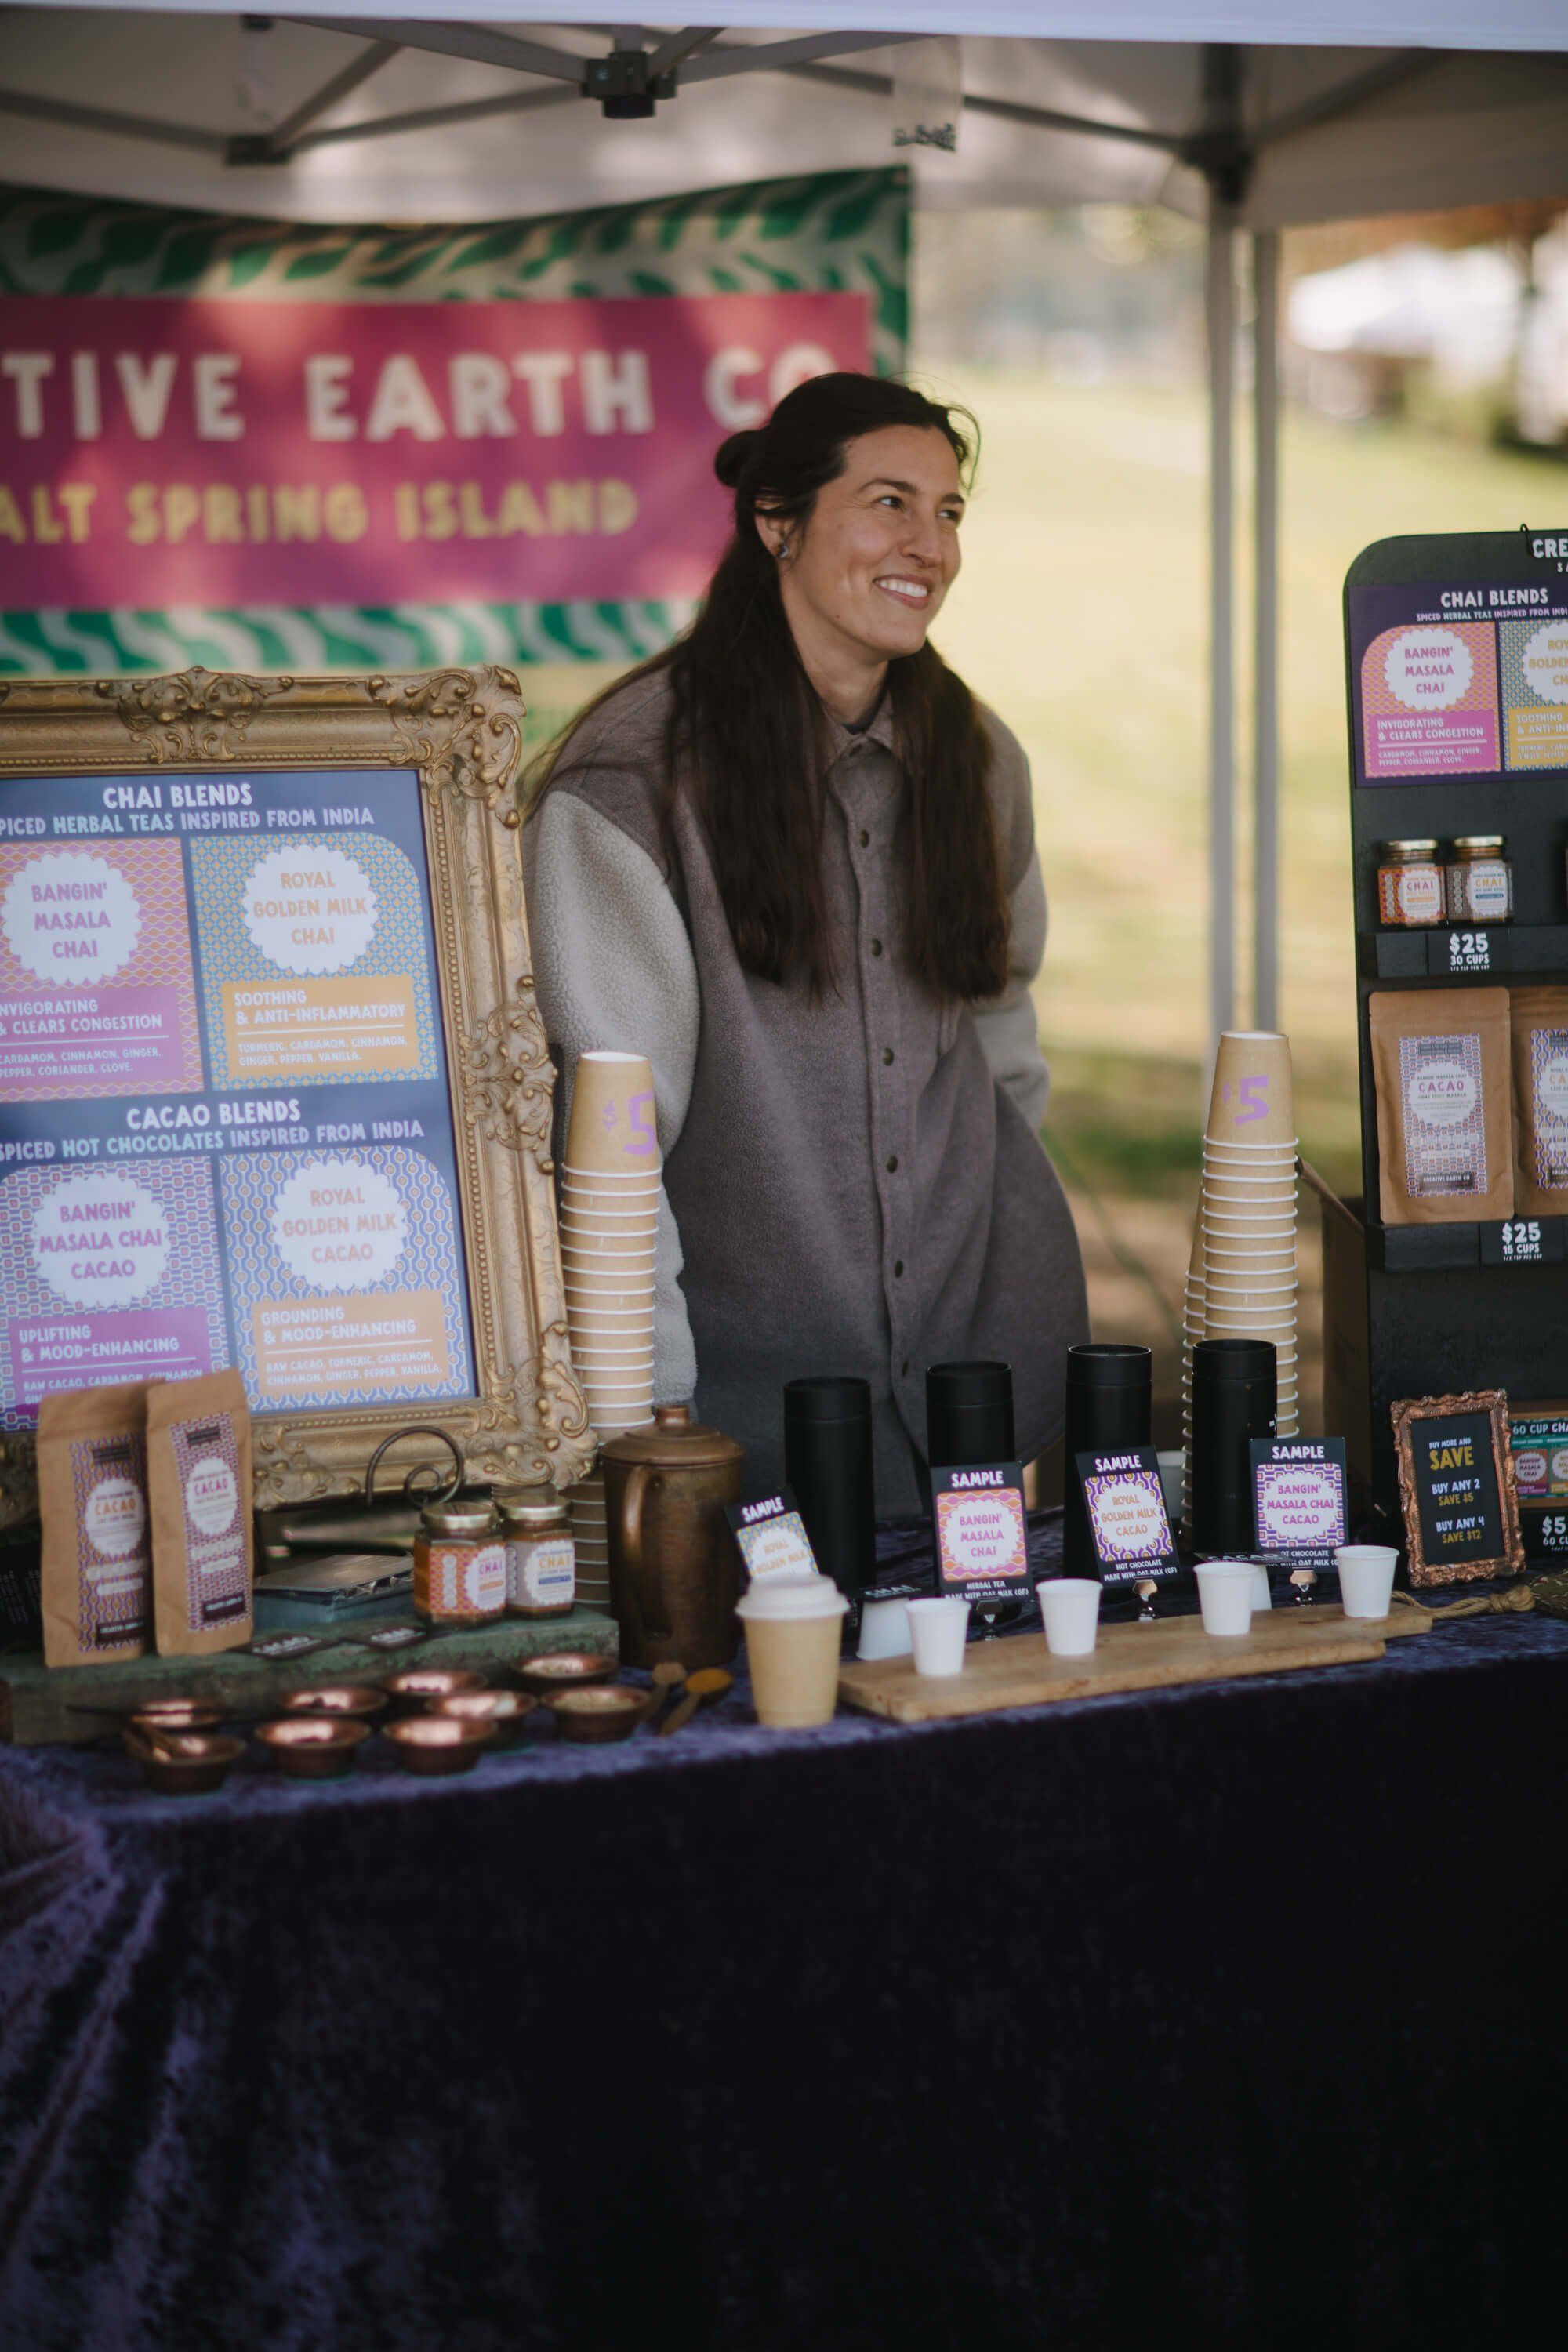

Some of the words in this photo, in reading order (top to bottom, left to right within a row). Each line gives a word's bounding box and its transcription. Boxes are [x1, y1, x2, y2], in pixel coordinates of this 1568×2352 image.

[3, 352, 245, 442] TIVE
[305, 349, 655, 443] EARTH
[125, 481, 368, 545] SPRING
[395, 475, 641, 541] ISLAND
[1441, 591, 1482, 608] CHAI
[1490, 588, 1548, 606] BLENDS
[1417, 613, 1441, 622] SPICED
[1443, 612, 1472, 620] HERBAL
[1474, 611, 1492, 619] TEAS
[1494, 609, 1526, 619] INSPIRED
[1529, 608, 1550, 617] FROM
[1404, 646, 1453, 659] BANGIN'
[1405, 665, 1454, 677] MASALA
[1416, 683, 1444, 694] CHAI
[1377, 717, 1443, 730] INVIGORATING
[1389, 730, 1422, 741] CLEARS
[1425, 728, 1483, 739] CONGESTION
[103, 786, 162, 809] CHAI
[170, 782, 252, 808] BLENDS
[53, 815, 125, 834] HERBAL
[129, 813, 175, 832] TEAS
[180, 811, 260, 830] INSPIRED
[267, 809, 317, 828] FROM
[323, 808, 375, 825] INDIA
[280, 871, 335, 889] ROYAL
[1406, 881, 1434, 891] CHAI
[1475, 877, 1503, 887] CHAI
[31, 882, 107, 902] BANGIN'
[252, 900, 321, 917] GOLDEN
[327, 898, 368, 916] MILK
[34, 911, 111, 931] MASALA
[291, 927, 335, 945] CHAI
[1450, 933, 1488, 955] $25
[52, 940, 98, 958] CHAI
[1450, 956, 1463, 966] 30
[1466, 953, 1490, 964] CUPS
[234, 990, 307, 1006] SOOTHING
[235, 1011, 249, 1025] &
[254, 1004, 405, 1024] ANTI-INFLAMMATORY
[13, 1018, 66, 1035] CLEARS
[71, 1014, 162, 1031] CONGESTION
[1418, 1080, 1464, 1092] CACAO
[126, 1104, 210, 1130] CACAO
[219, 1099, 301, 1125] BLENDS
[62, 1138, 100, 1158] HOT
[107, 1131, 224, 1155] CHOCOLATES
[230, 1127, 310, 1148] INSPIRED
[316, 1123, 366, 1142] FROM
[372, 1120, 425, 1139] INDIA
[310, 1187, 365, 1207] ROYAL
[60, 1201, 136, 1223] BANGIN'
[282, 1217, 349, 1237] GOLDEN
[357, 1214, 397, 1232] MILK
[1501, 1221, 1541, 1243] $25
[39, 1231, 114, 1254] MASALA
[119, 1229, 162, 1247] CHAI
[1516, 1243, 1540, 1254] CUPS
[311, 1243, 373, 1263] CACAO
[71, 1259, 136, 1279] CACAO
[261, 1306, 344, 1325] GROUNDING
[19, 1325, 92, 1344] UPLIFTING
[263, 1330, 276, 1345] &
[281, 1319, 416, 1342] MOOD-ENHANCING
[21, 1348, 34, 1363] &
[40, 1337, 180, 1361] MOOD-ENHANCING
[1512, 1425, 1526, 1435] 60
[1530, 1424, 1548, 1434] CUP
[1272, 1446, 1324, 1459] SAMPLE
[1429, 1446, 1474, 1470] SAVE
[1095, 1455, 1142, 1472] SAMPLE
[194, 1478, 228, 1495] CACAO
[951, 1470, 1004, 1488] SAMPLE
[1432, 1482, 1448, 1494] BUY
[1452, 1479, 1471, 1492] ANY
[1474, 1479, 1480, 1490] 2
[1277, 1483, 1322, 1494] BANGIN'
[94, 1498, 136, 1515] CACAO
[1112, 1494, 1140, 1506] ROYAL
[1267, 1499, 1307, 1510] MASALA
[1310, 1499, 1334, 1509] CHAI
[1439, 1494, 1460, 1505] SAVE
[1463, 1492, 1473, 1504] $5
[742, 1496, 784, 1523] SAMPLE
[1102, 1511, 1134, 1523] GOLDEN
[1137, 1508, 1156, 1519] MILK
[959, 1512, 1003, 1526] BANGIN'
[1282, 1515, 1319, 1525] CACAO
[1436, 1520, 1453, 1532] BUY
[1456, 1517, 1475, 1530] ANY
[1478, 1515, 1484, 1526] 4
[1542, 1515, 1566, 1537] $5
[960, 1530, 1004, 1542] MASALA
[1116, 1524, 1148, 1537] CACAO
[1443, 1531, 1465, 1544] SAVE
[1466, 1530, 1481, 1541] $12
[1543, 1537, 1555, 1546] 60
[971, 1546, 996, 1557] CHAI
[539, 1555, 571, 1570] CHAI
[1129, 1559, 1162, 1569] CHOCOLATE
[1104, 1573, 1120, 1581] MADE
